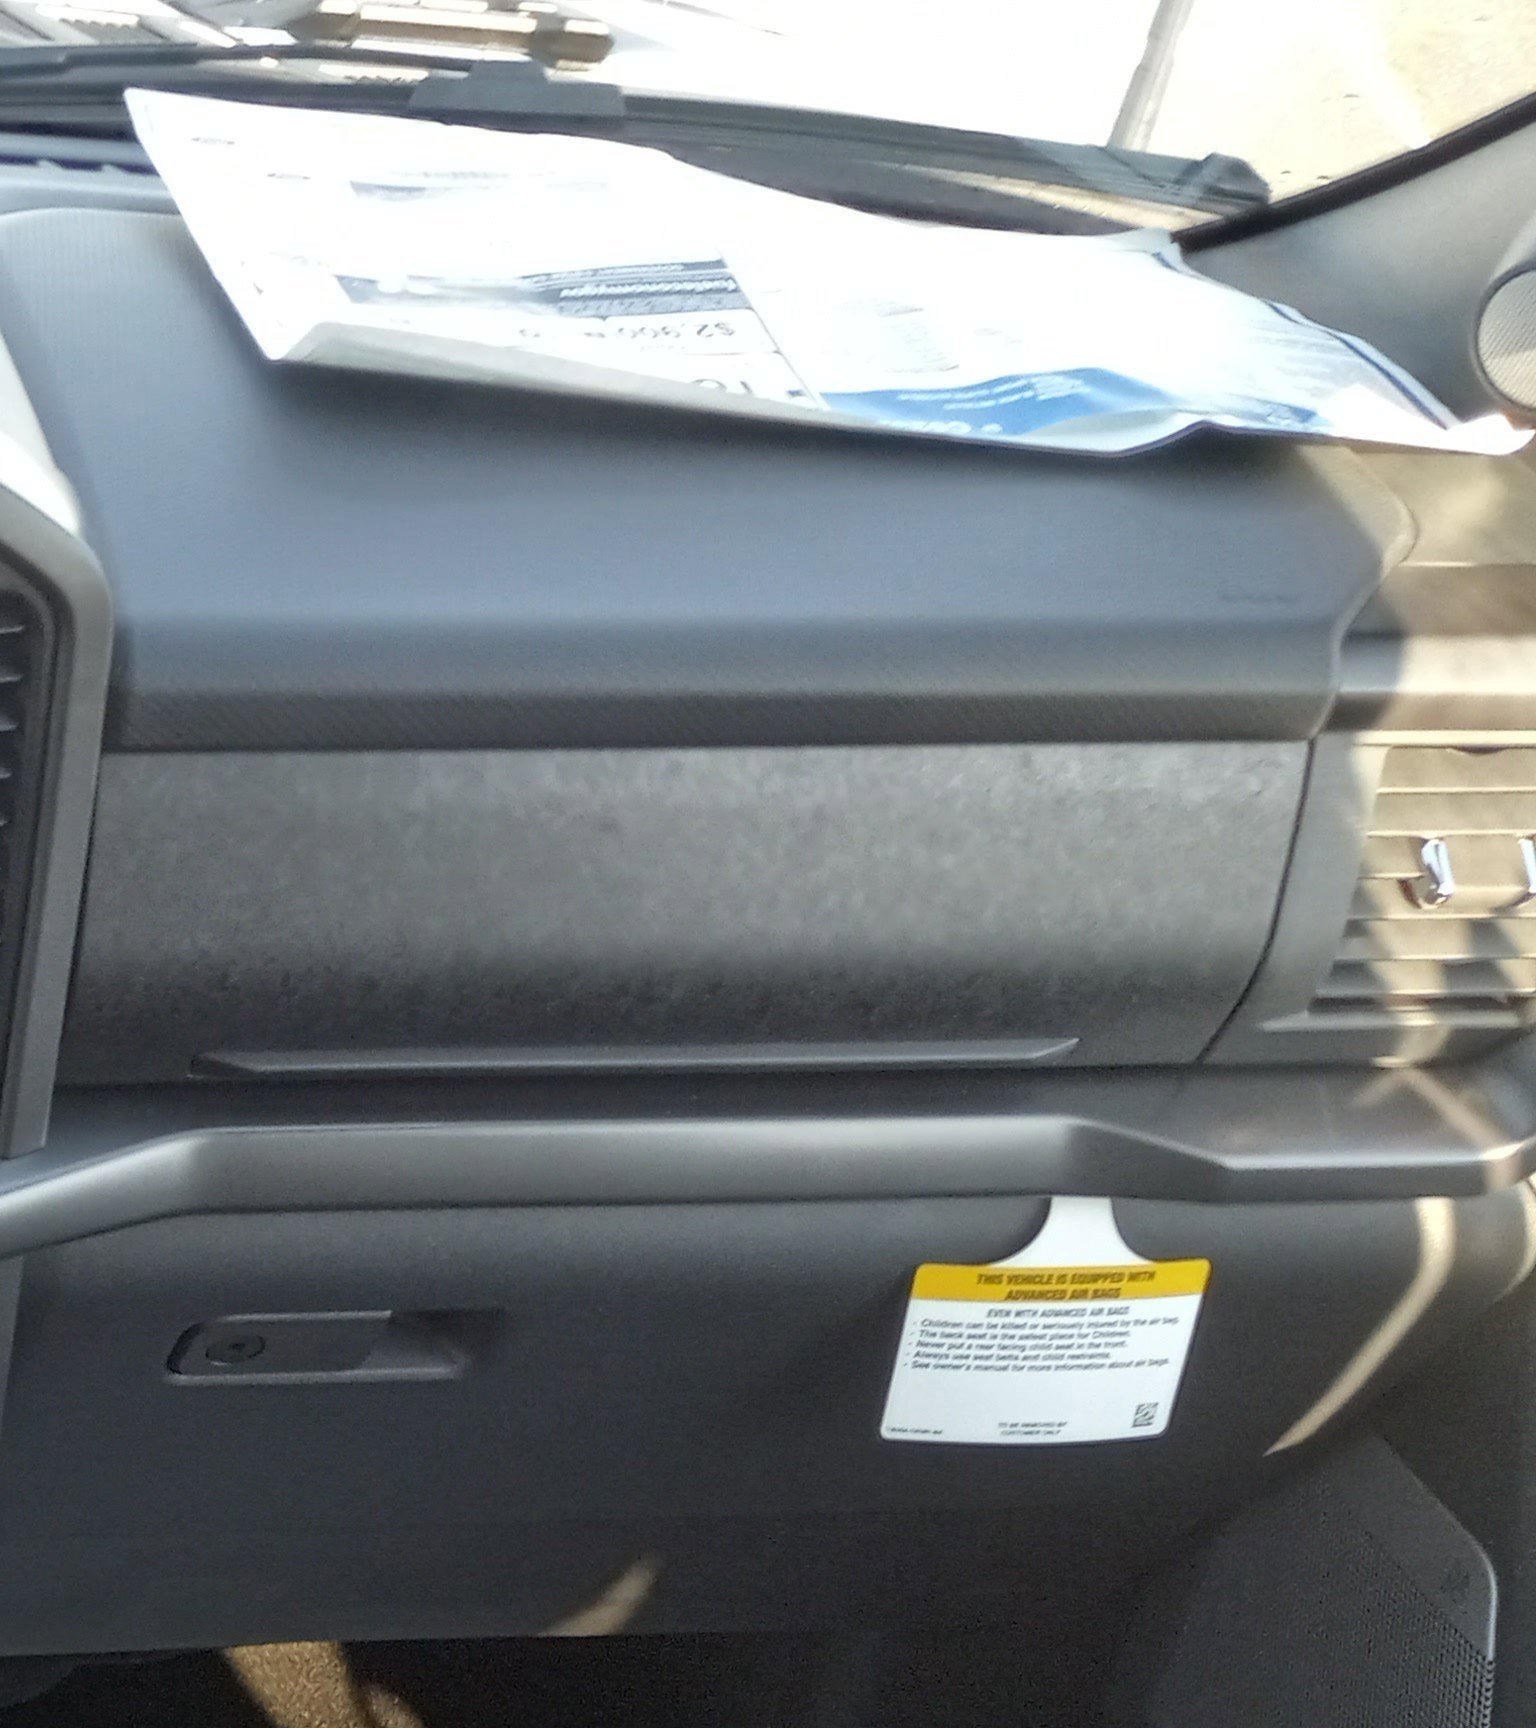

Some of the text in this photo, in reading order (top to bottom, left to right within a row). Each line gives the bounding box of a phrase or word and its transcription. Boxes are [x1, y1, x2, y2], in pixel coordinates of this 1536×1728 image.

[977, 1270, 1157, 1285] THIS VEHICLE IS EQUIPPED WITH
[1004, 1287, 1123, 1301] ADVANCED AIR BAGS
[987, 1306, 1131, 1318] EVEN WITH ADVANCED AIR BAGS
